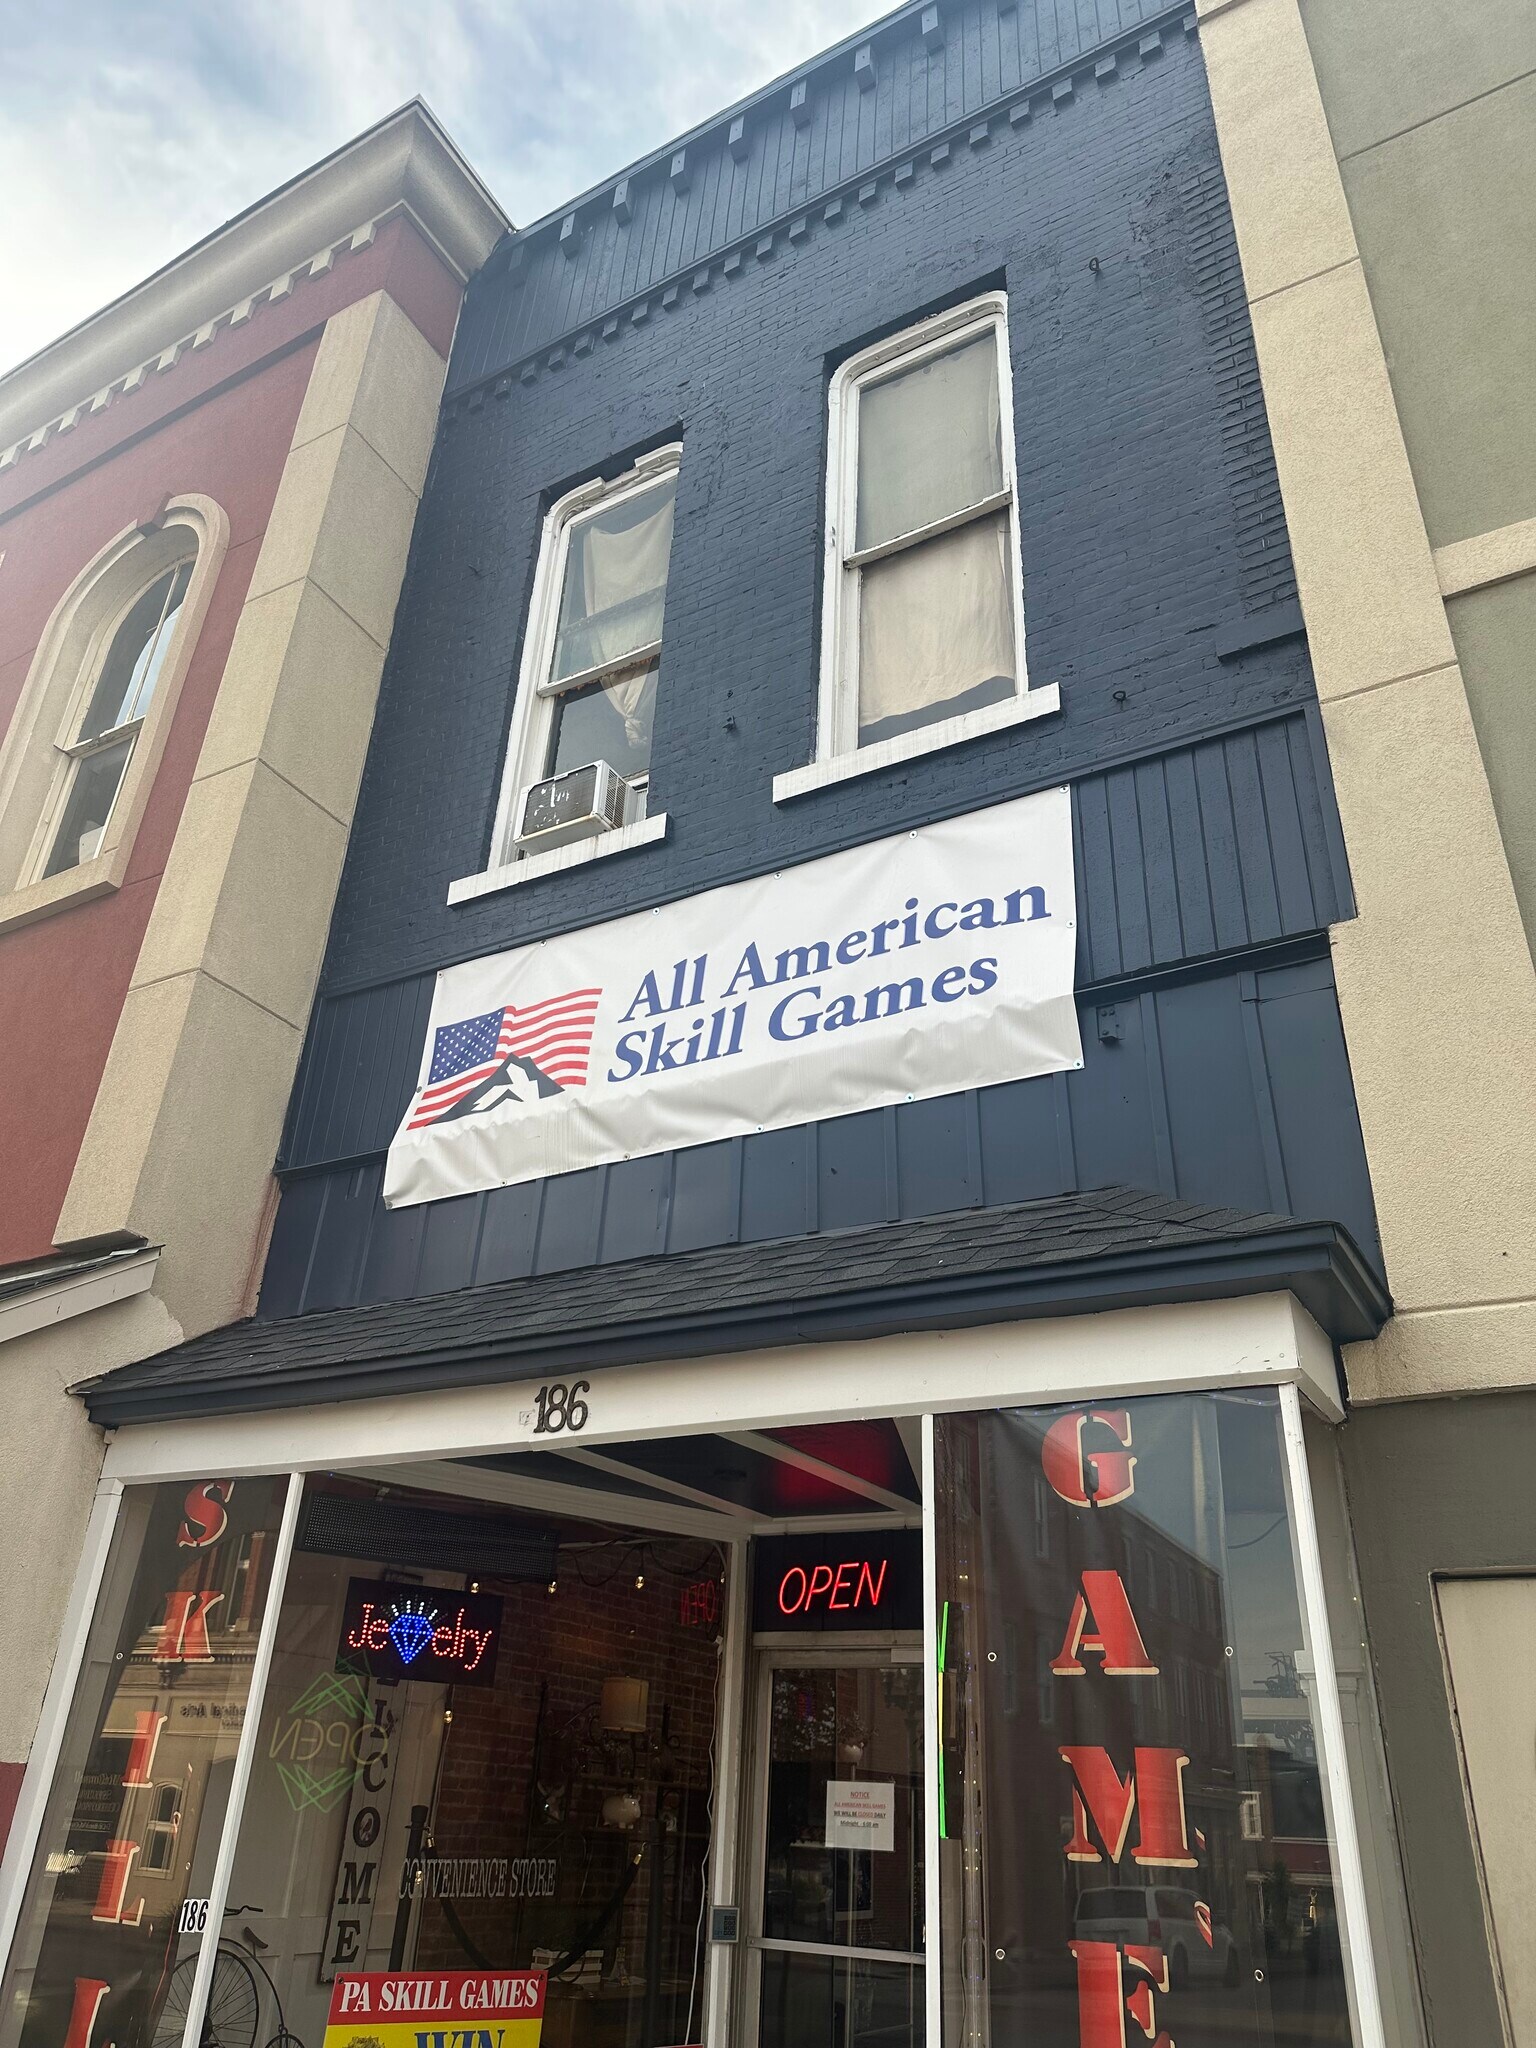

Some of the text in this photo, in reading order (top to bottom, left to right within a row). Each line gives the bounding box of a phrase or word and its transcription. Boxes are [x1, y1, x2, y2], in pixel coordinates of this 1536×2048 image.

[617, 884, 1052, 1022] All American
[606, 956, 999, 1083] Skill Games
[533, 1380, 591, 1434] 186
[779, 1558, 887, 1614] OPEN
[398, 1857, 557, 1900] CONVENIENCE STORE
[180, 1900, 209, 1931] 186
[339, 1977, 540, 2013] PA SKILL GAMES
